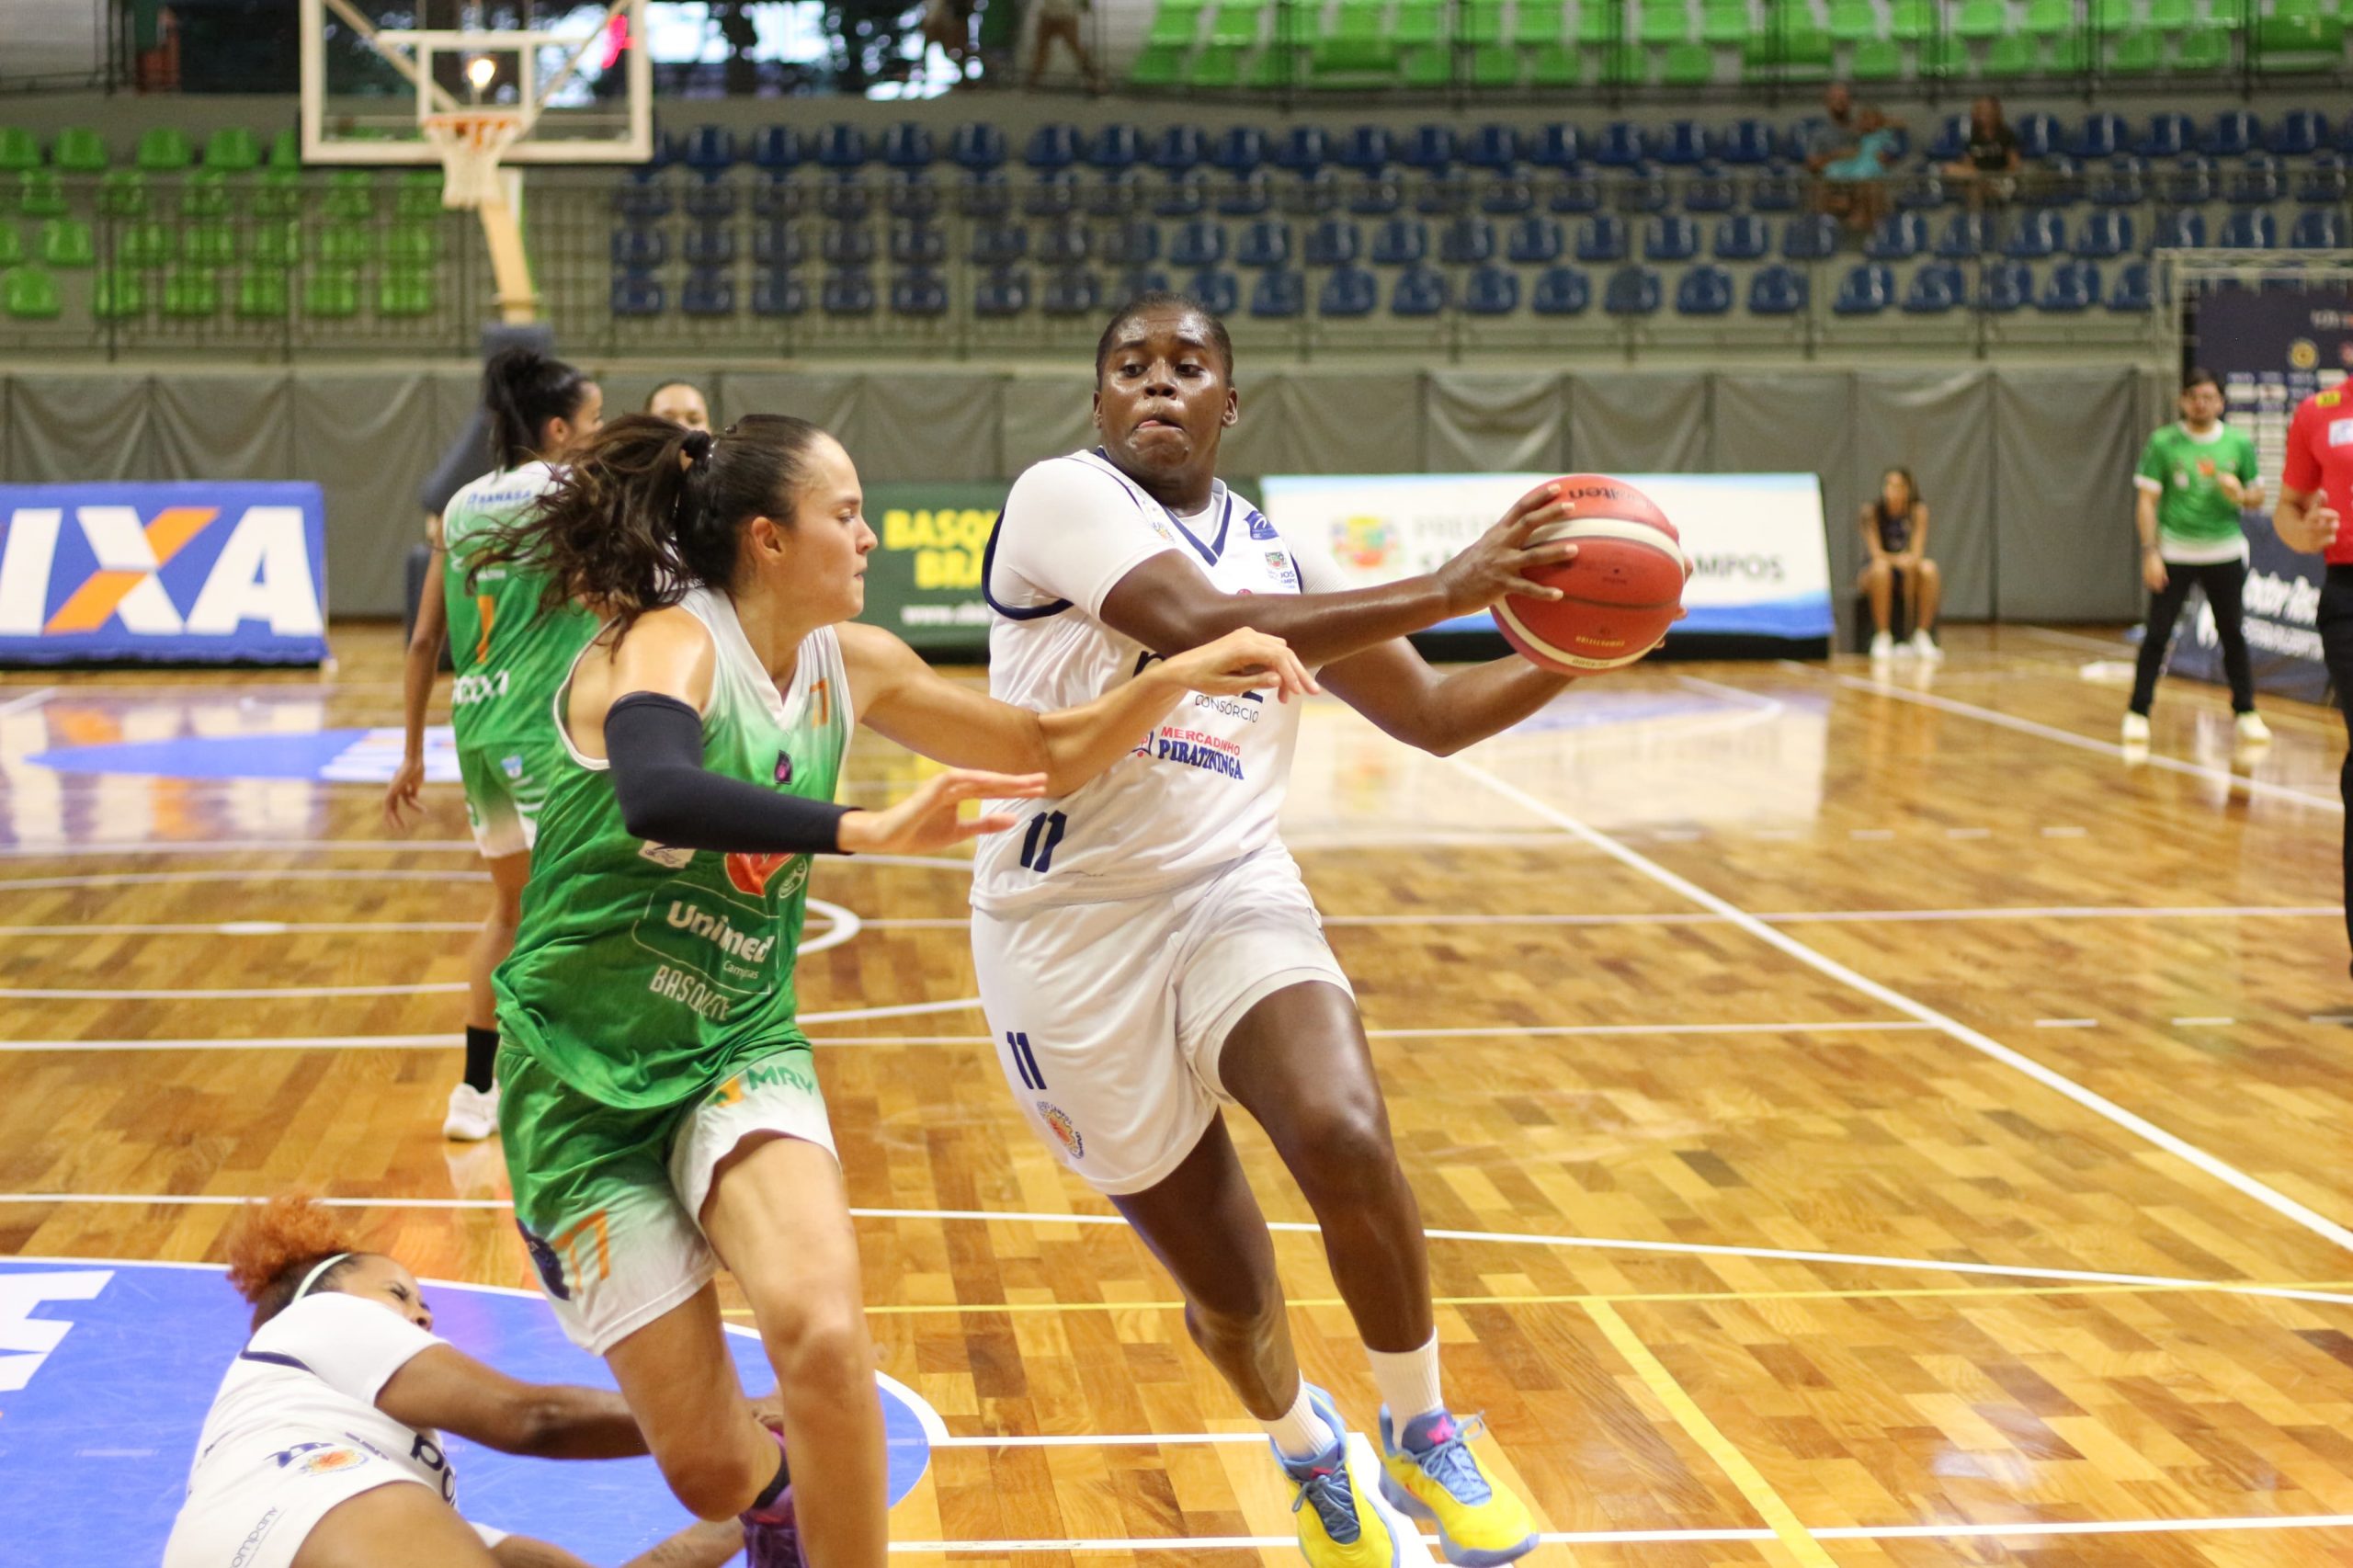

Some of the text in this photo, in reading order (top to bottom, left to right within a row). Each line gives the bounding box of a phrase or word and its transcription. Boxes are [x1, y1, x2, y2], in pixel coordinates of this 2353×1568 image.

[1692, 554, 1786, 585] MPOS
[1195, 694, 1259, 723] CONSÓRCIO
[1157, 739, 1245, 780] PIRATININGA
[1161, 726, 1241, 756] MERCADINHO
[1020, 810, 1068, 873] 11
[666, 900, 776, 963] Unimed
[1006, 1030, 1048, 1090] 11
[229, 1506, 278, 1568] ompany
